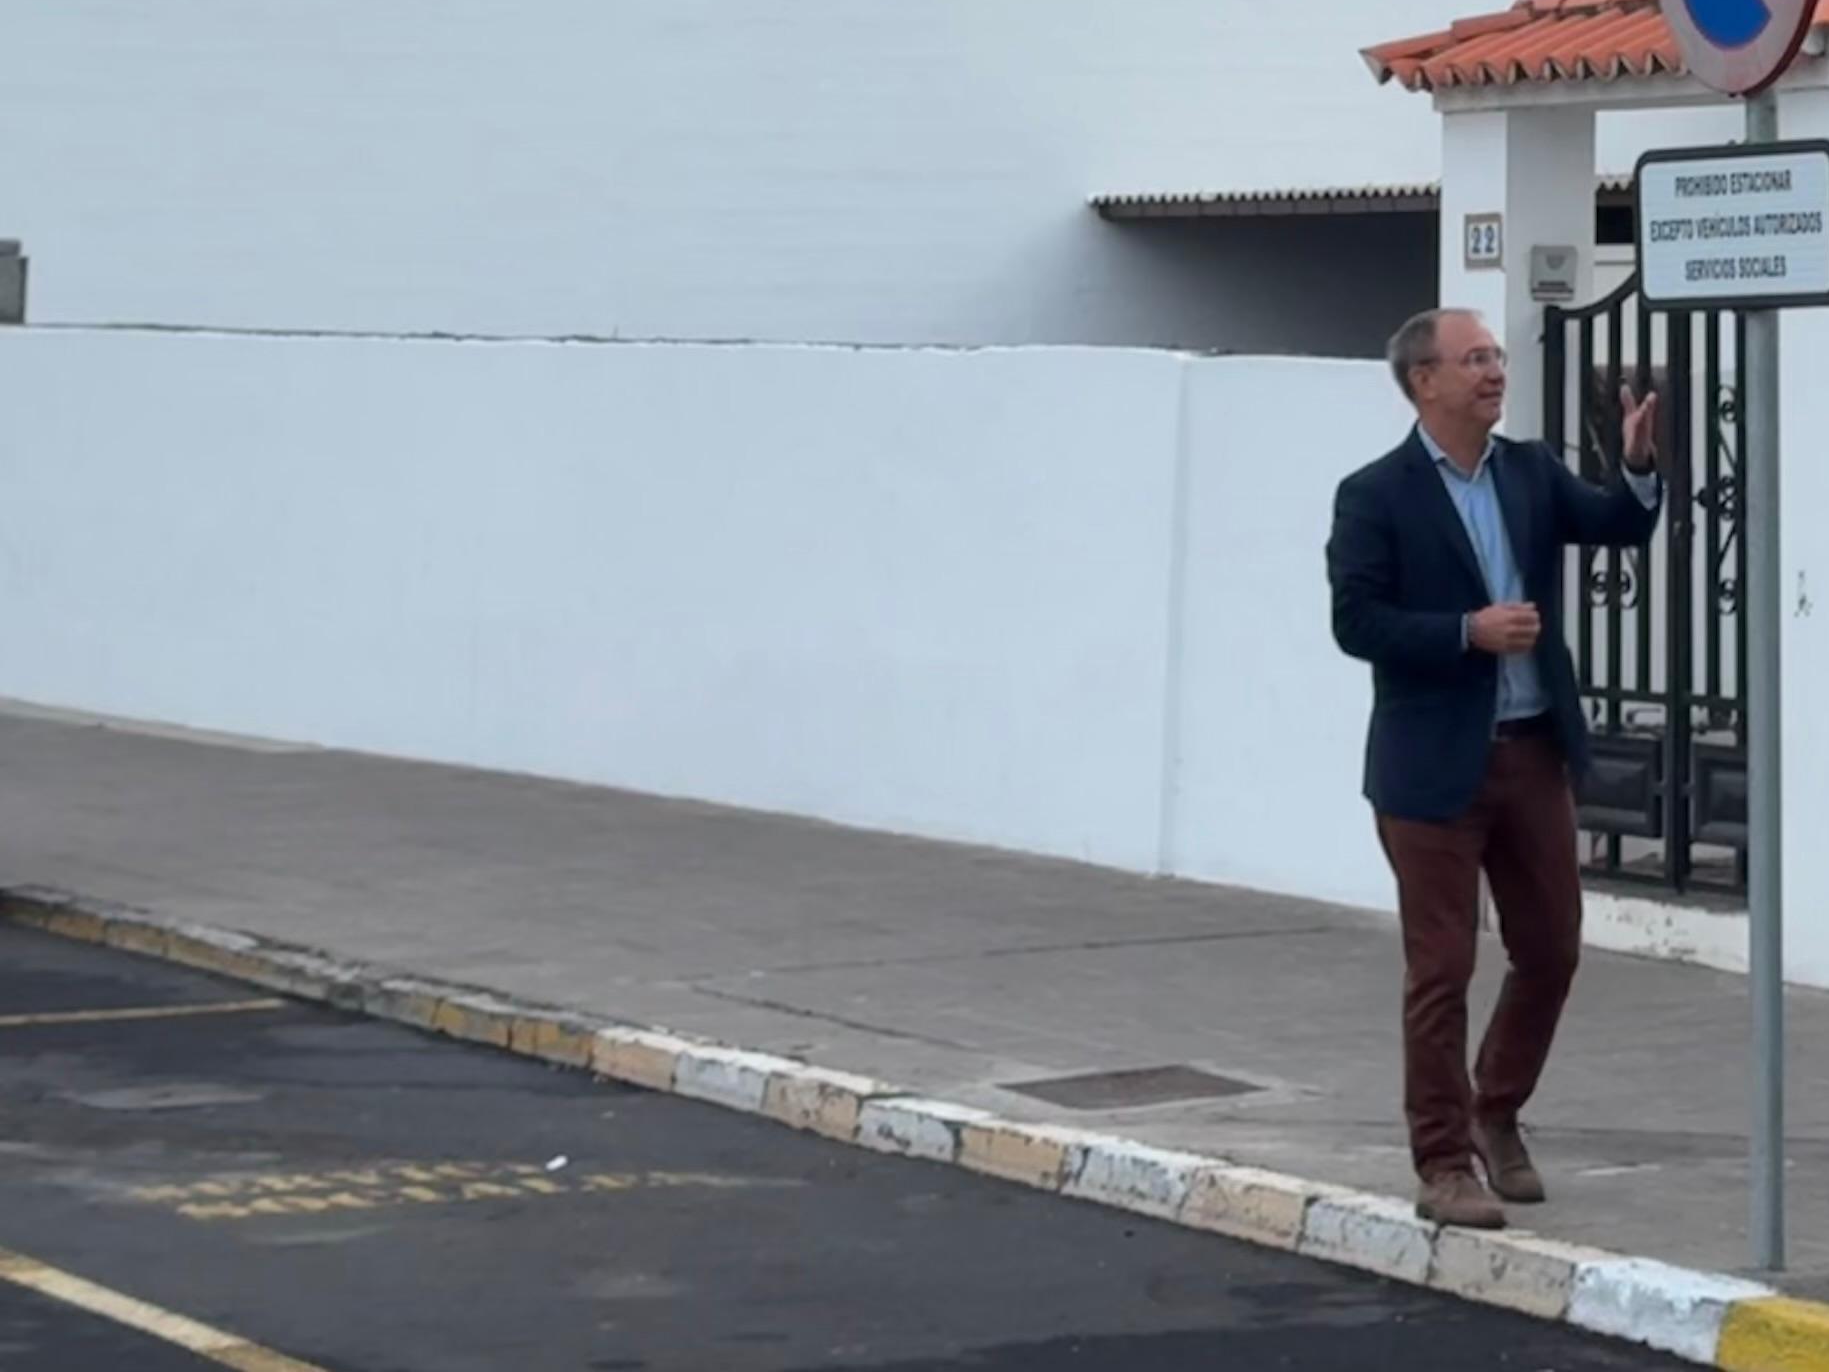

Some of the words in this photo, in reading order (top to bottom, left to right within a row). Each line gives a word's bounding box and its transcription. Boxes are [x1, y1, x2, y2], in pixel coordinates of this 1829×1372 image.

[1675, 174, 1727, 198] PROHIBIDO
[1730, 169, 1792, 195] ESTACIONAR
[1471, 225, 1495, 254] 22
[1650, 217, 1693, 242] EXCEPTO
[1753, 211, 1822, 236] AUTORIZADOS
[1685, 258, 1735, 281] SERVICIOS
[1738, 255, 1786, 279] SOCIALES
